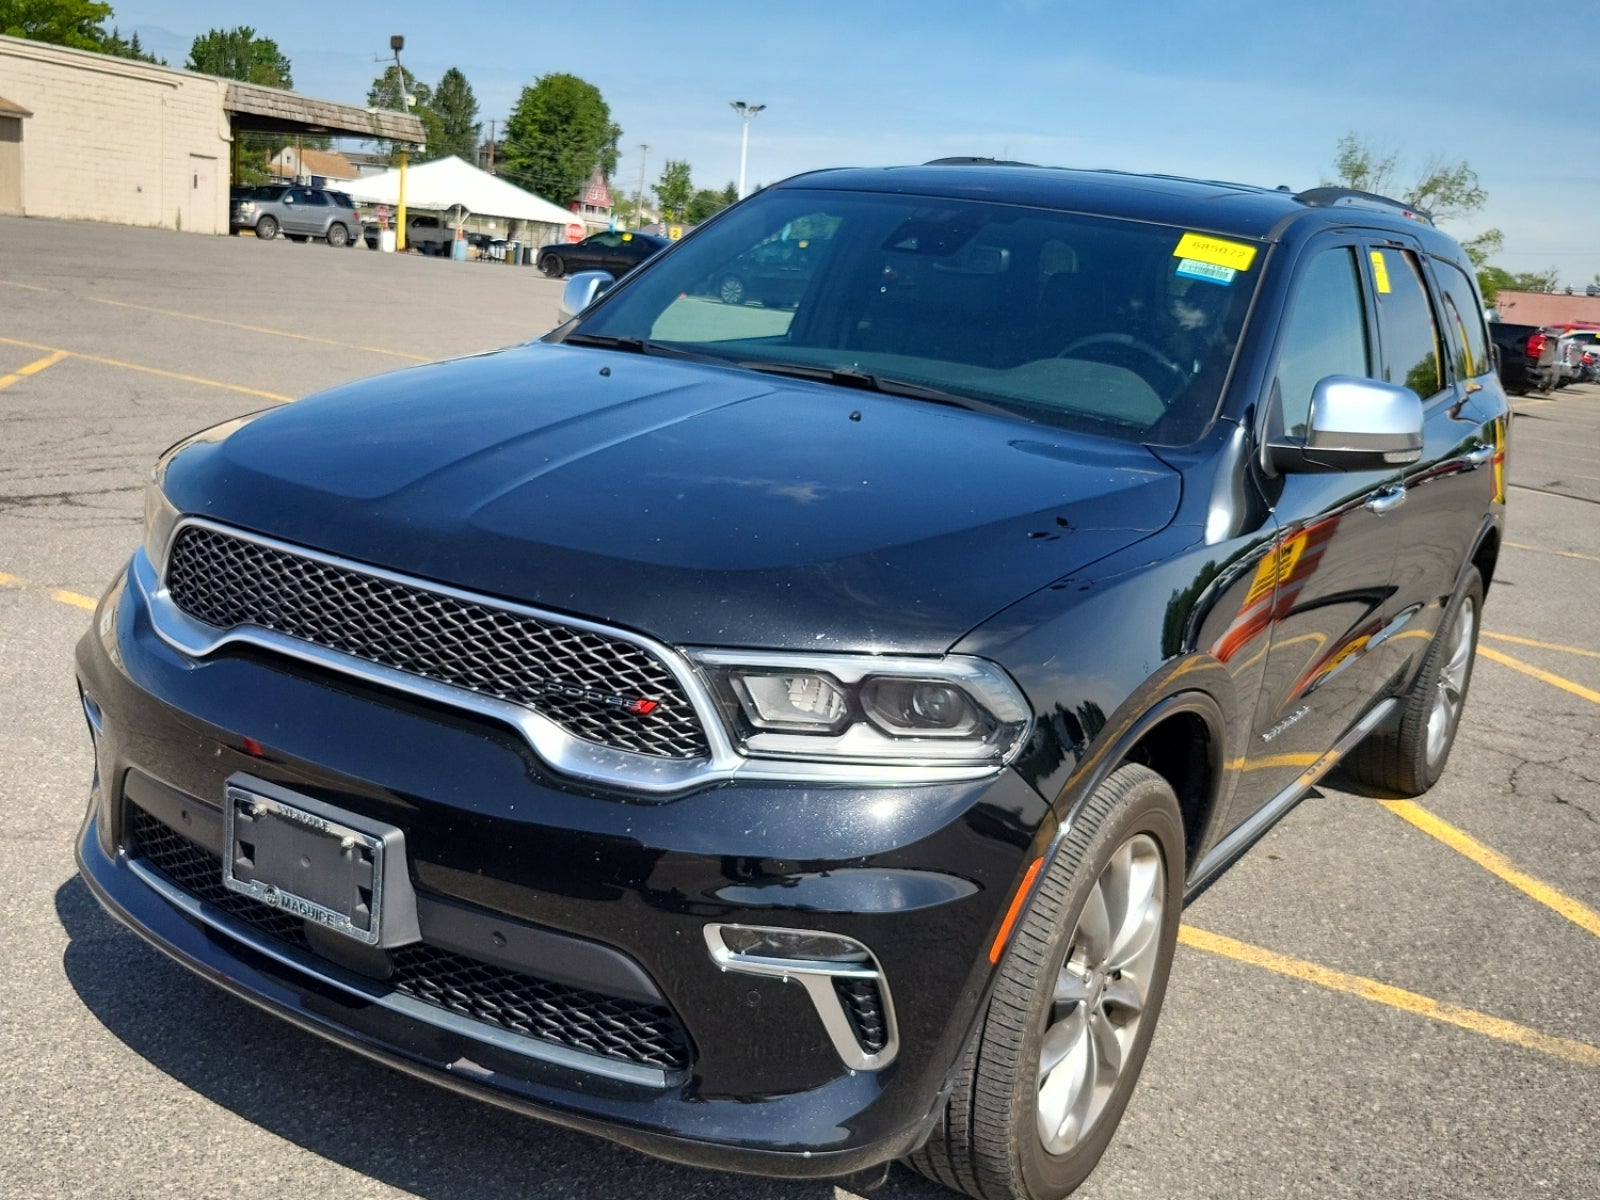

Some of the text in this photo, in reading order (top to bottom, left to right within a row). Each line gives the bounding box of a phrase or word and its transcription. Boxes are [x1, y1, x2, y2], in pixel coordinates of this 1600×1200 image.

[1192, 241, 1246, 258] 685072
[545, 682, 640, 709] DODGE
[281, 894, 336, 927] MAGUIRE
